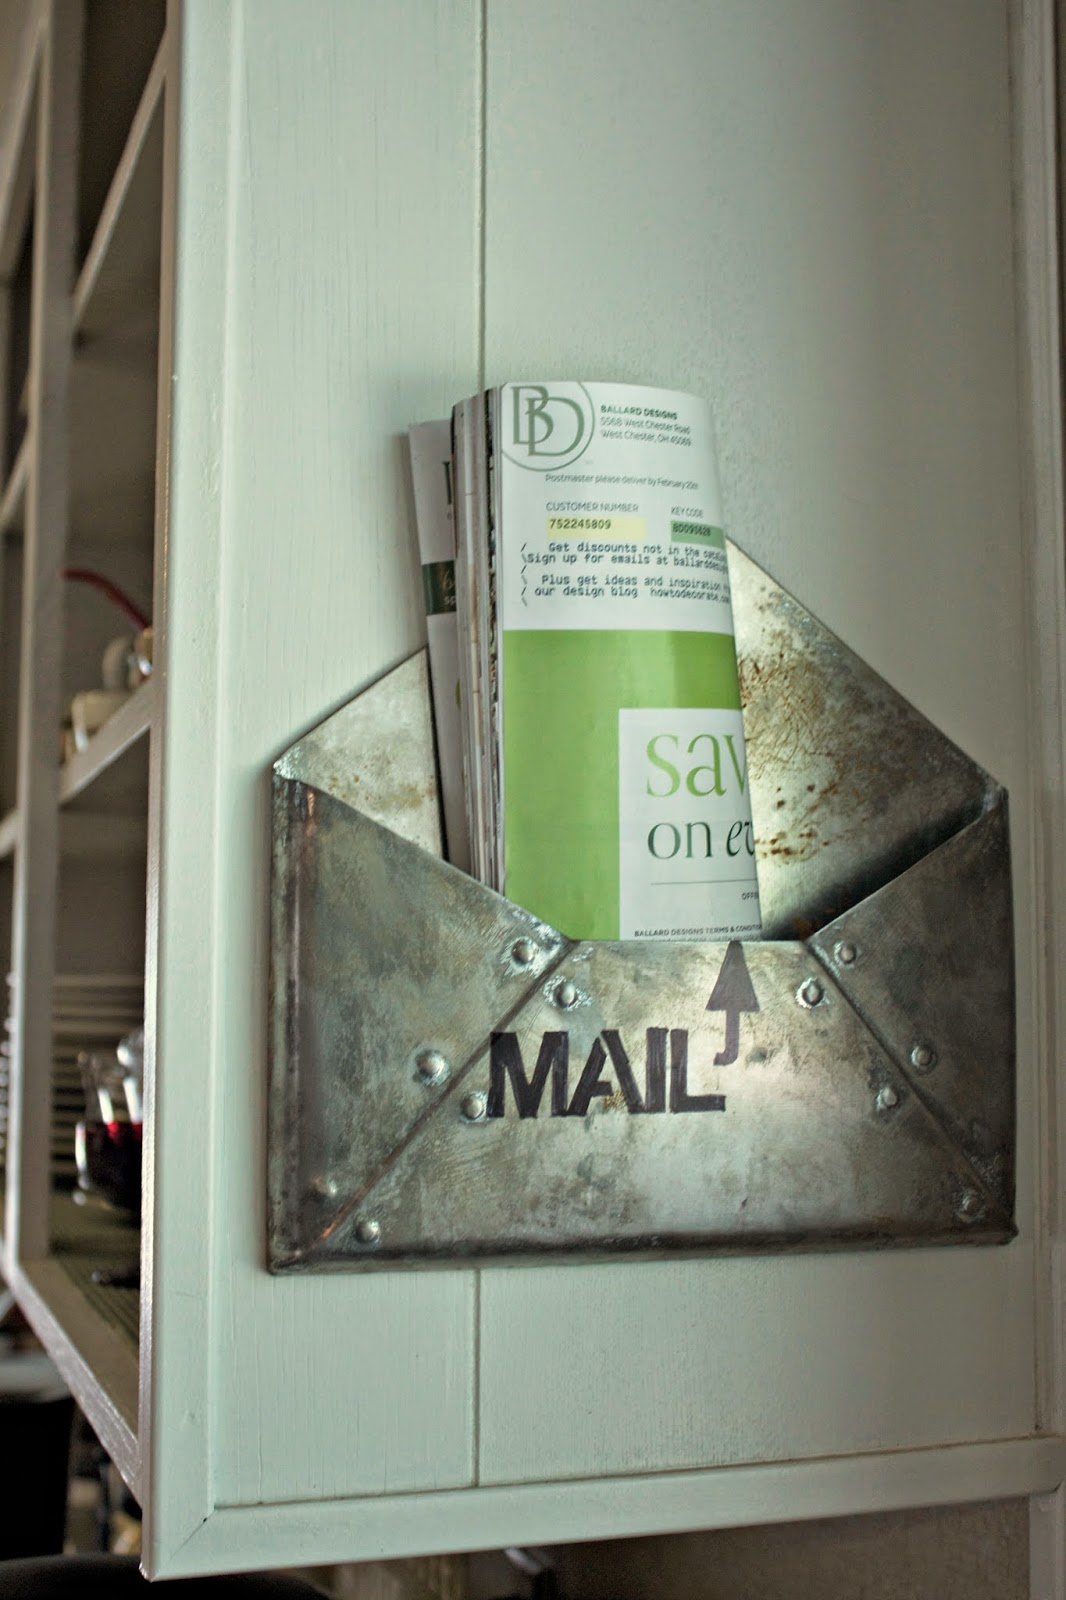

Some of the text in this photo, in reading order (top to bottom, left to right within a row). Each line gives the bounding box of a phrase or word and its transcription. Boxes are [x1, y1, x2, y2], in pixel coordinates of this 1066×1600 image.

[600, 404, 678, 421] BALLARD DESIGNS
[624, 418, 645, 429] West
[645, 419, 674, 432] Chester
[600, 429, 623, 440] West
[545, 473, 594, 483] Postmaster
[594, 475, 620, 485] please
[546, 501, 639, 513] CUSTOMER NUMBER
[671, 506, 686, 516] KEY
[549, 518, 612, 530] 752245809
[548, 542, 570, 552] Get
[577, 542, 637, 554] discounts
[643, 543, 662, 554] not
[668, 545, 679, 555] in
[684, 546, 700, 558] the
[527, 553, 556, 565] Sign
[562, 554, 577, 564] up
[585, 553, 604, 563] for
[611, 553, 650, 565] emails
[656, 555, 668, 565] at
[541, 574, 570, 585] Plus
[577, 575, 598, 587] get
[605, 574, 638, 586] ideas
[644, 576, 663, 586] and
[534, 588, 555, 597] our
[562, 586, 605, 598] design
[611, 586, 638, 598] blog
[647, 821, 713, 860] on
[634, 928, 670, 937] BALLARD
[670, 927, 704, 936] DESIGNS
[705, 925, 729, 935] TERMS
[487, 1027, 726, 1119] MAIL
